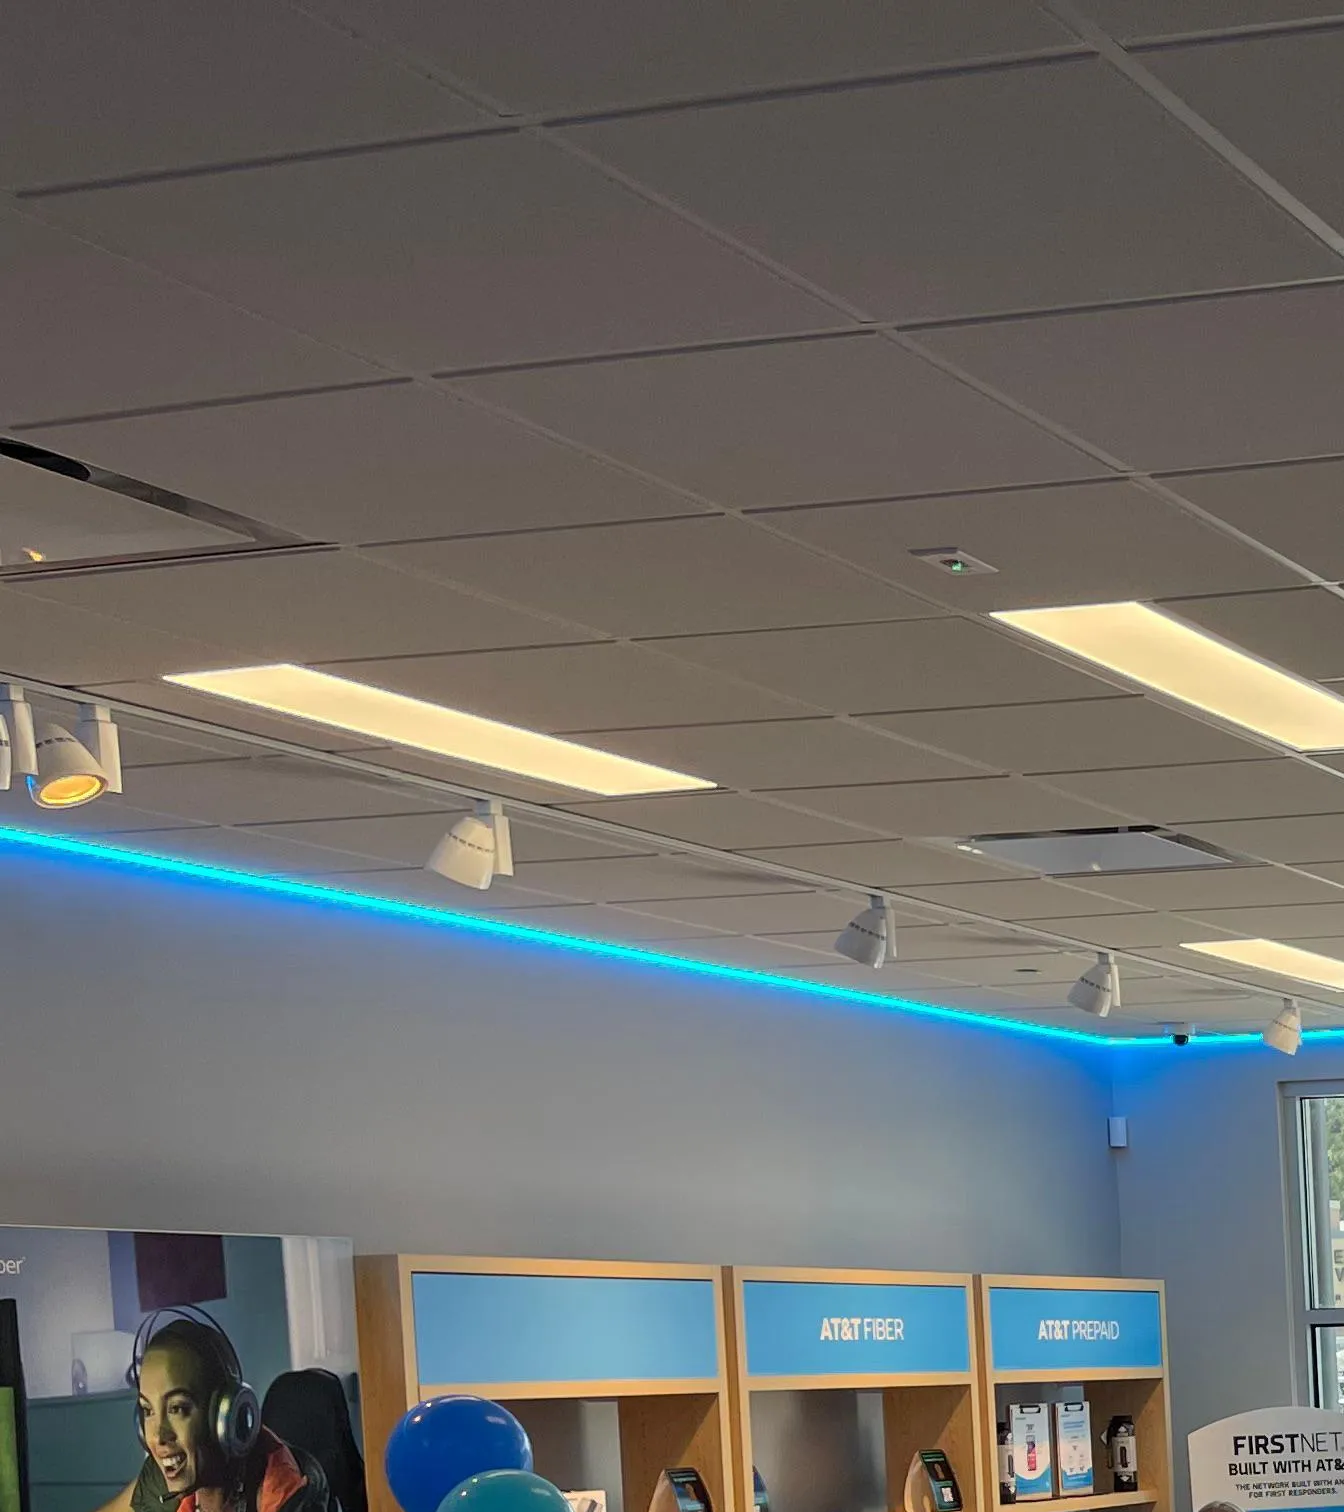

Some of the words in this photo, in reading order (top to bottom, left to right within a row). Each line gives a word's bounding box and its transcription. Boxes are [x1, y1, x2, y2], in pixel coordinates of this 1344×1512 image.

[820, 1317, 861, 1341] AT&T
[863, 1317, 904, 1341] FIBER
[1037, 1319, 1070, 1341] AT&T
[1071, 1319, 1120, 1341] PREPAID
[1233, 1432, 1343, 1456] FIRSTNET
[1228, 1461, 1269, 1476] BUILT
[1273, 1459, 1312, 1474] WITH
[1253, 1481, 1289, 1489] NETWORK
[1291, 1480, 1311, 1488] BUILT
[1313, 1479, 1333, 1487] WITH
[1248, 1491, 1263, 1499] FOR
[1265, 1490, 1286, 1498] FIRST
